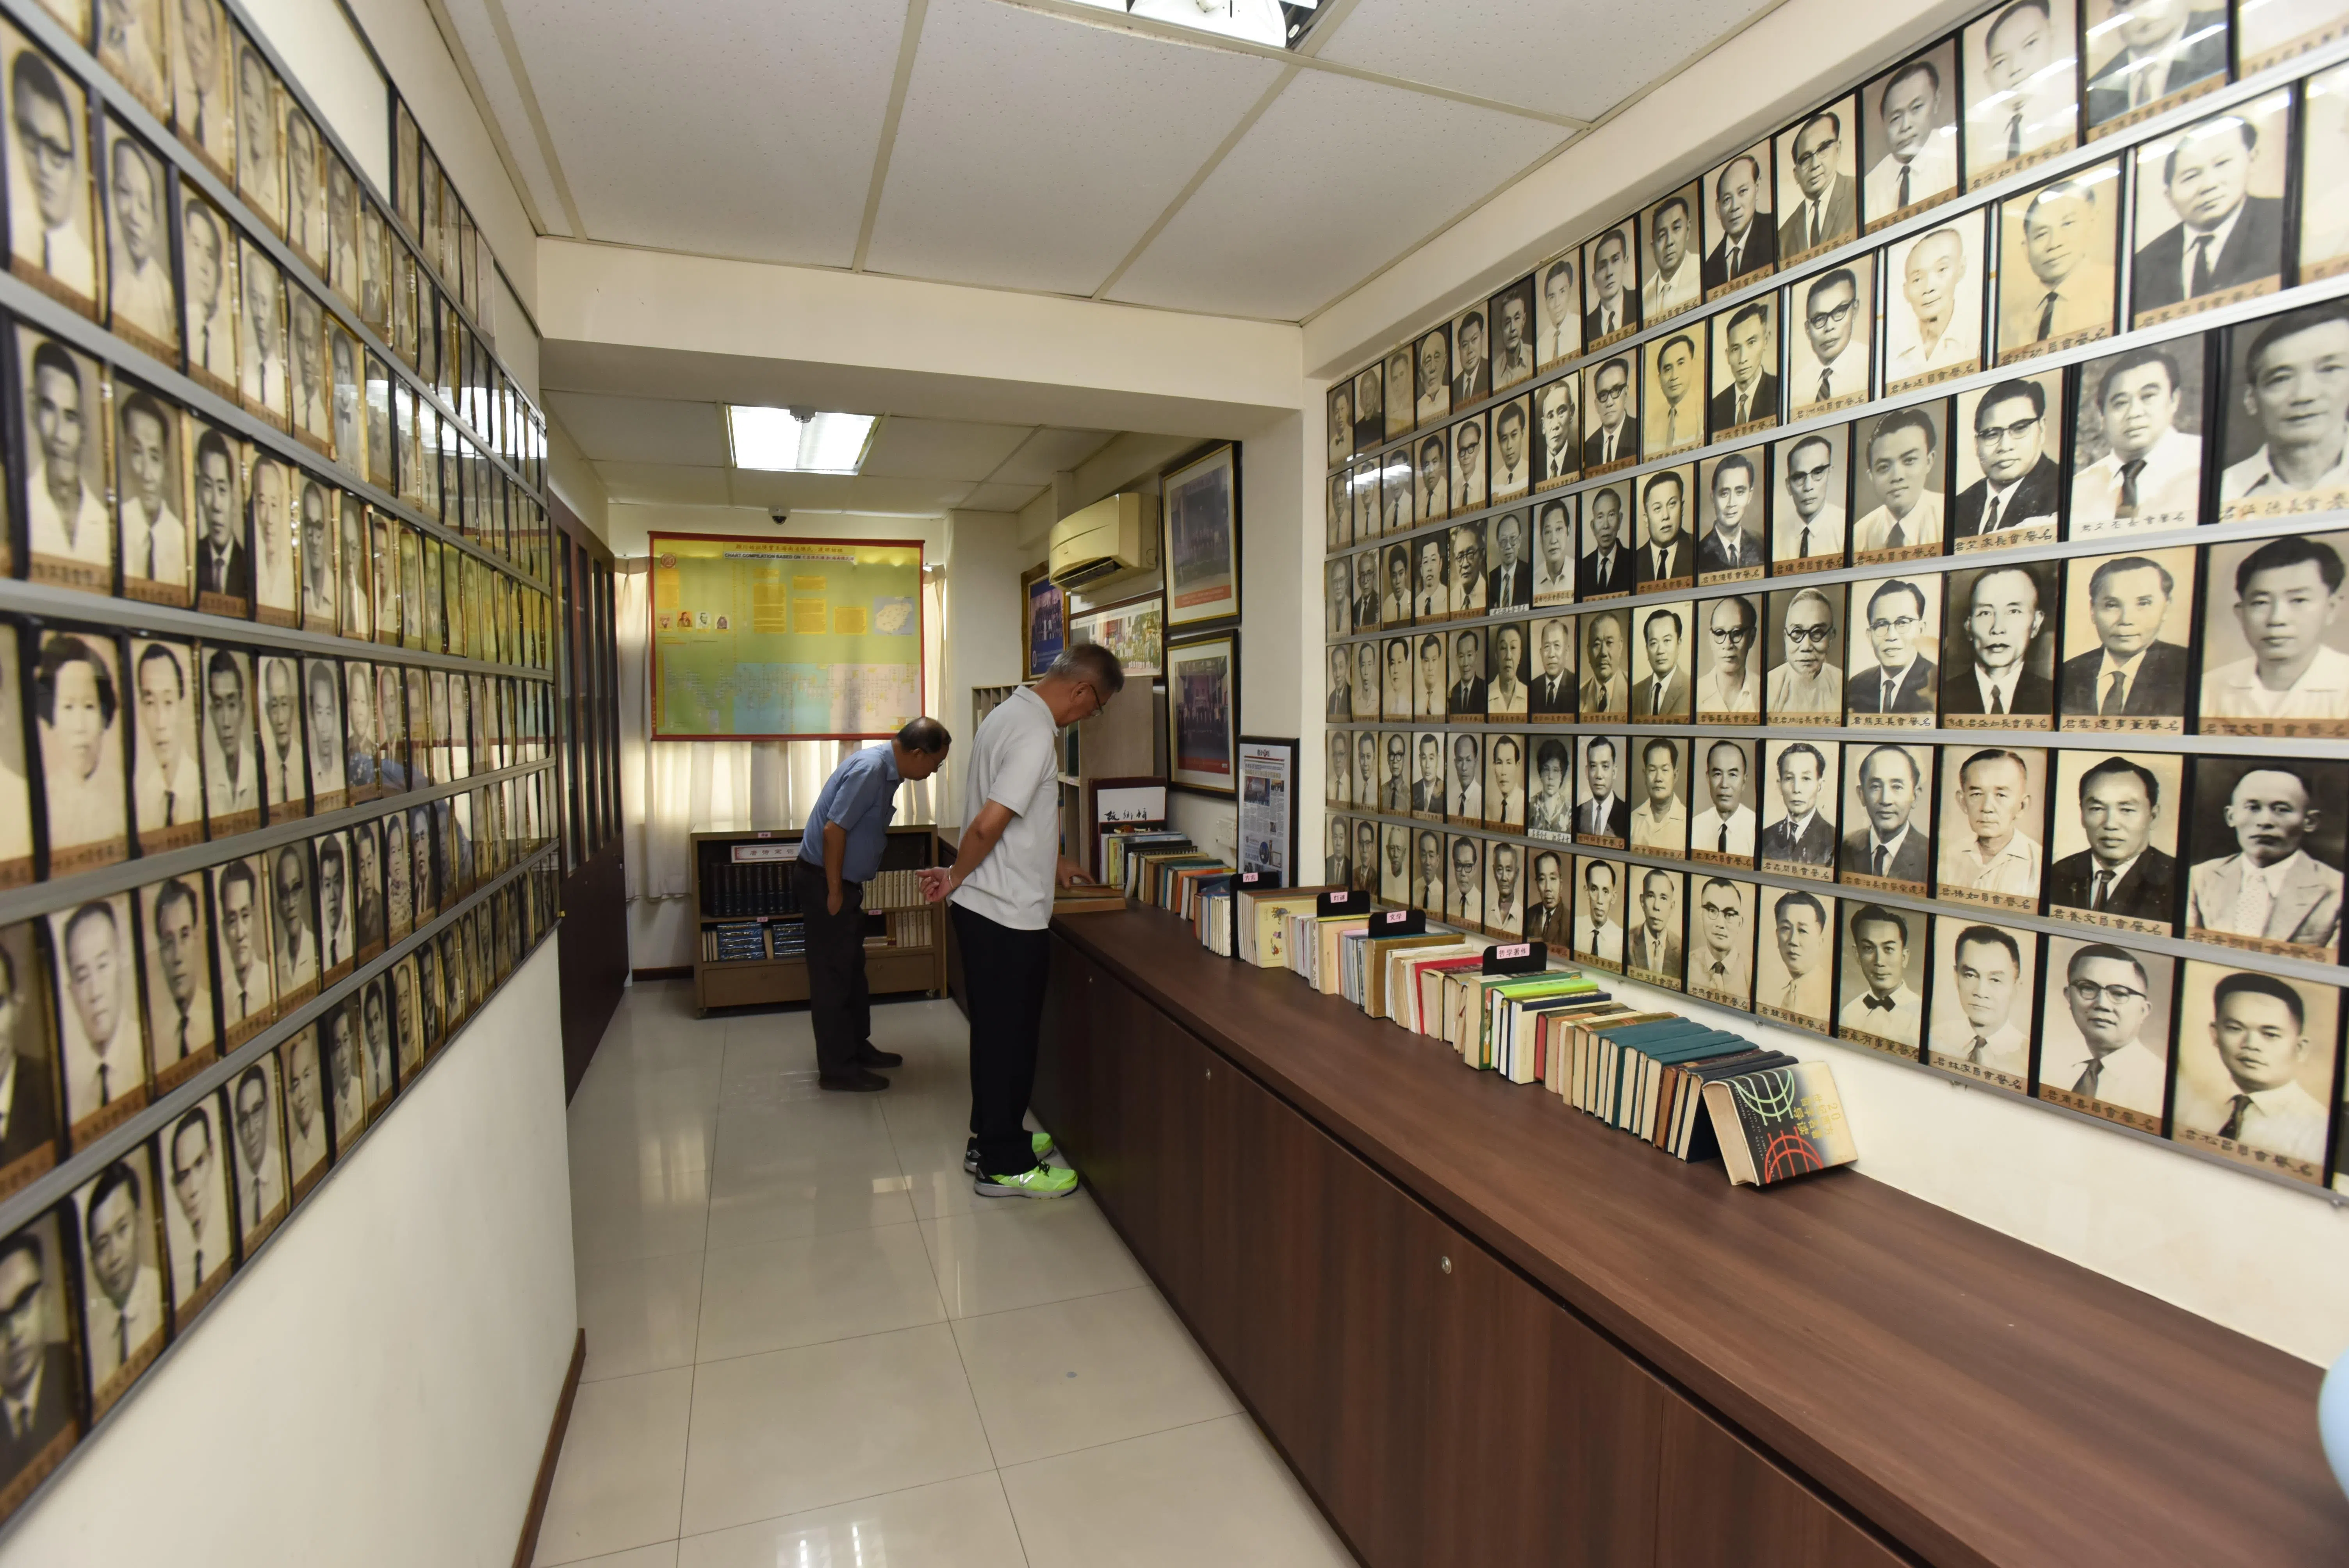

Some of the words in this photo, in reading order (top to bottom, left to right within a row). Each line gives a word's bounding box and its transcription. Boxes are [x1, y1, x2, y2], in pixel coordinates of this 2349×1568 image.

[1390, 913, 1402, 921] 文学
[1499, 948, 1527, 957] 哲学著作
[1793, 1107, 1809, 1135] 导读
